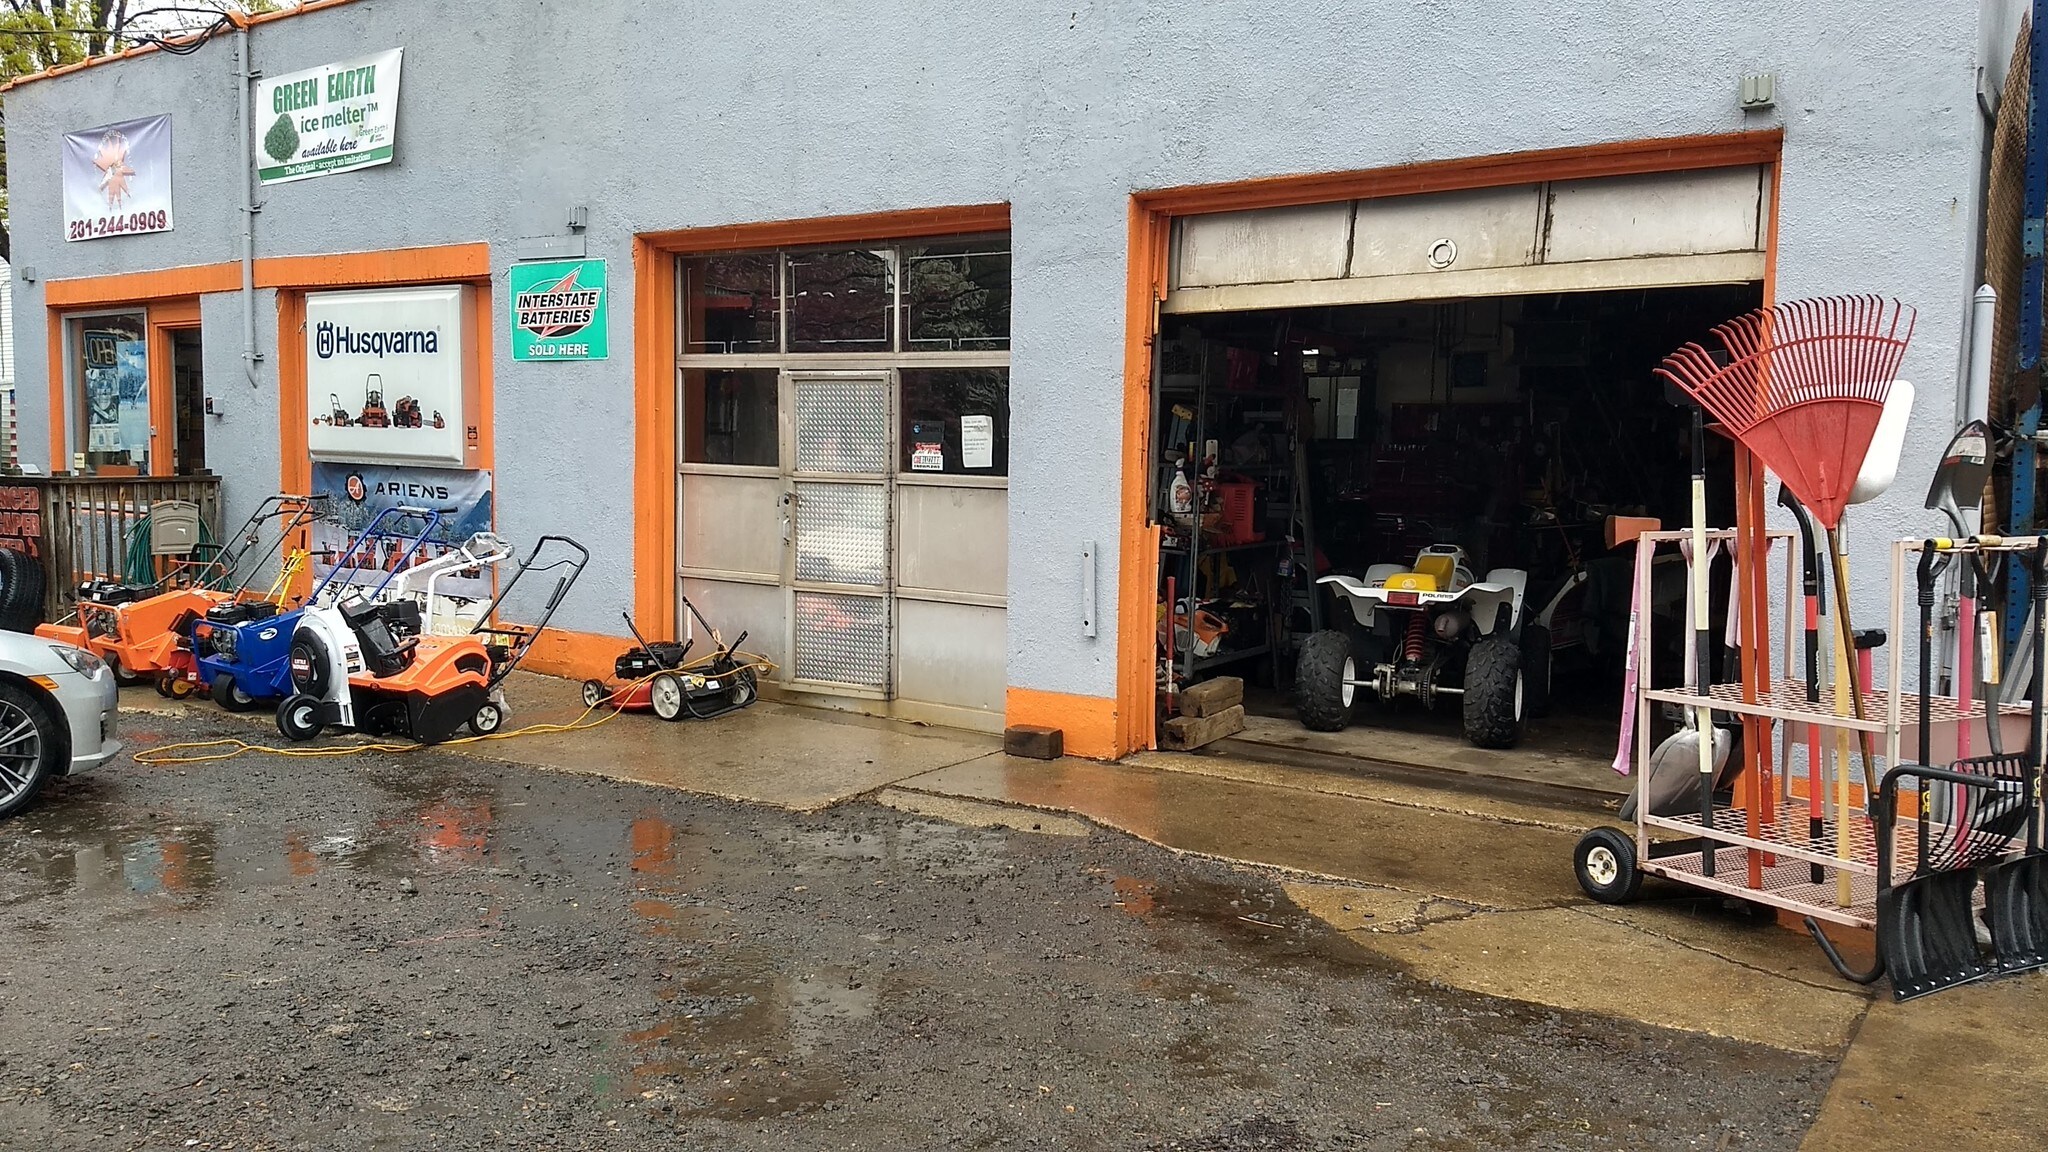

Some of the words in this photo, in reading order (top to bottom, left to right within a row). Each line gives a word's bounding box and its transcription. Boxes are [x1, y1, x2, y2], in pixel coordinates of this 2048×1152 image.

[273, 78, 318, 115] GREEN
[328, 65, 376, 103] EARTH
[301, 116, 318, 133] ice
[301, 139, 338, 159] available
[339, 136, 358, 152] here
[284, 165, 295, 175] The
[296, 161, 316, 174] Original
[318, 159, 337, 170] accept
[337, 158, 344, 166] no
[345, 153, 371, 164] imitations
[70, 210, 167, 239] 201-244-0909
[518, 292, 597, 308] INTERSTATE
[520, 309, 591, 325] BATTERIES
[336, 326, 438, 358] Husqvarna
[529, 344, 556, 356] SOLD
[559, 343, 589, 355] HERE
[374, 482, 449, 500] ARIENS
